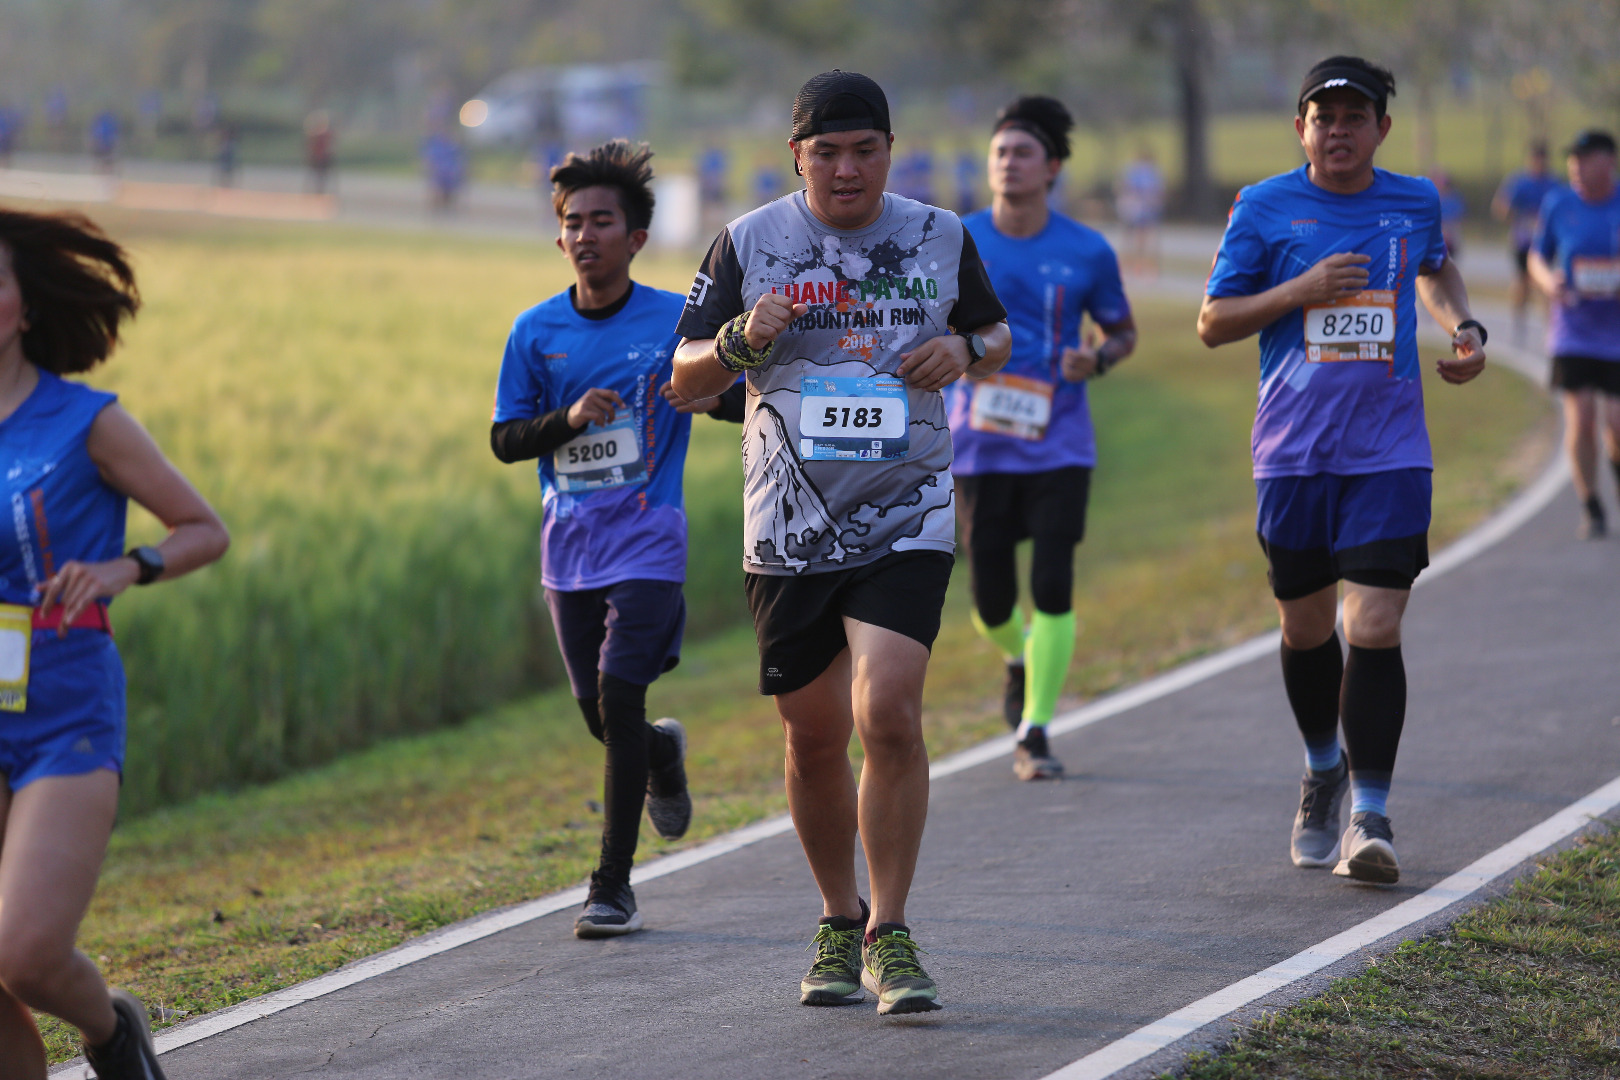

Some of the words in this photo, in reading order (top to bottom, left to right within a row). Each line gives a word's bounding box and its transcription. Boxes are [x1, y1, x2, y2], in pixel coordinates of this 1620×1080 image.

[890, 307, 926, 326] RUN
[1322, 313, 1384, 336] 8250
[842, 333, 874, 350] 2018
[822, 406, 883, 428] 5183
[568, 439, 618, 465] 5200
